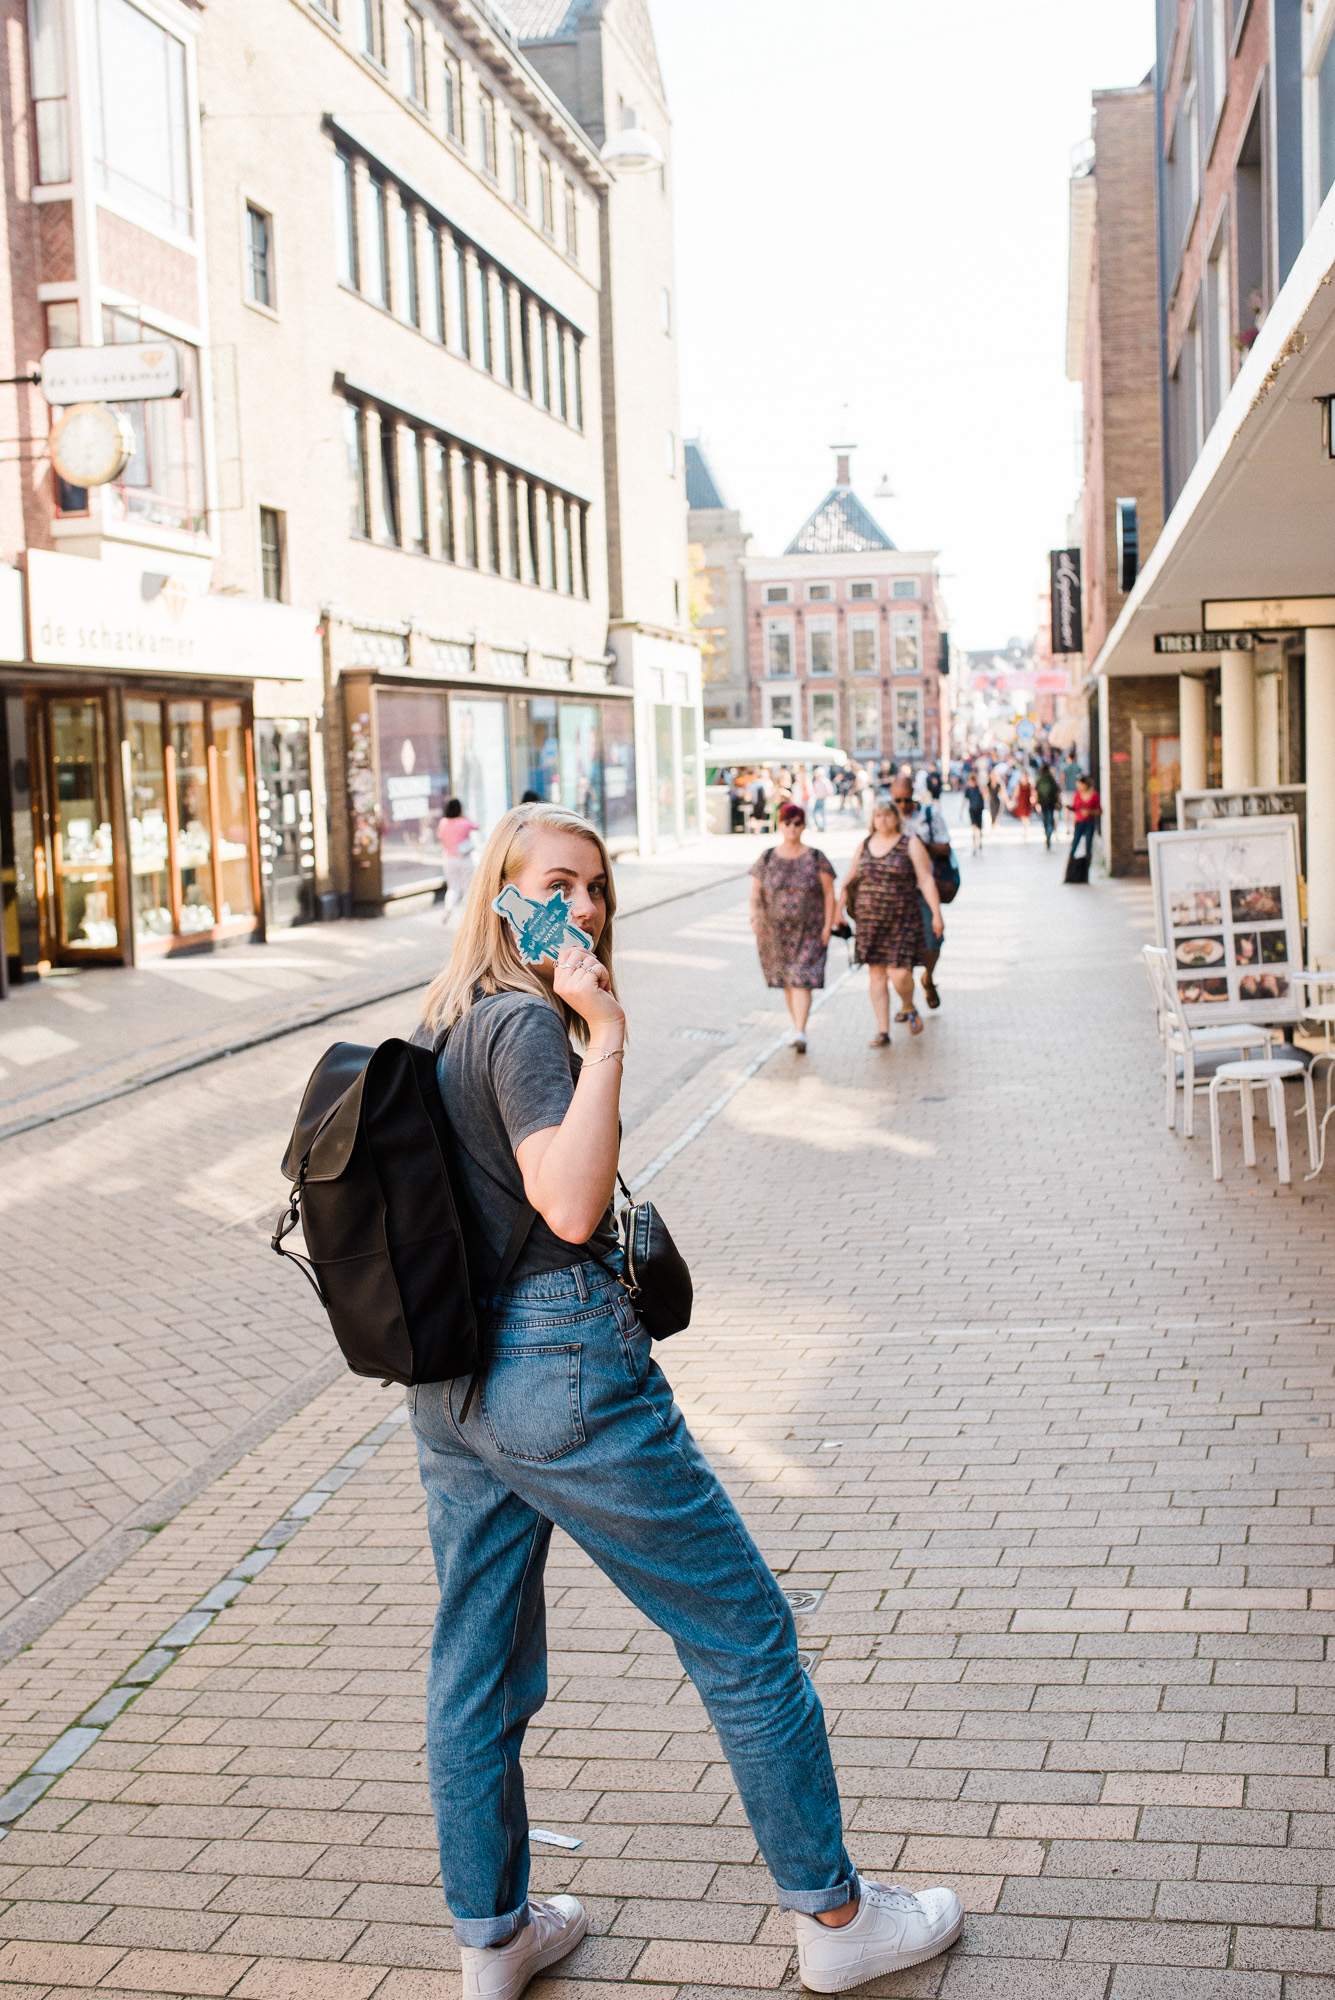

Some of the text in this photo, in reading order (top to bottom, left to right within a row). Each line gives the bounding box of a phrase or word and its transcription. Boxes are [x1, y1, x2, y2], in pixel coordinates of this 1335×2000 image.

[40, 613, 196, 656] de schatkamer
[542, 922, 560, 943] WATER
